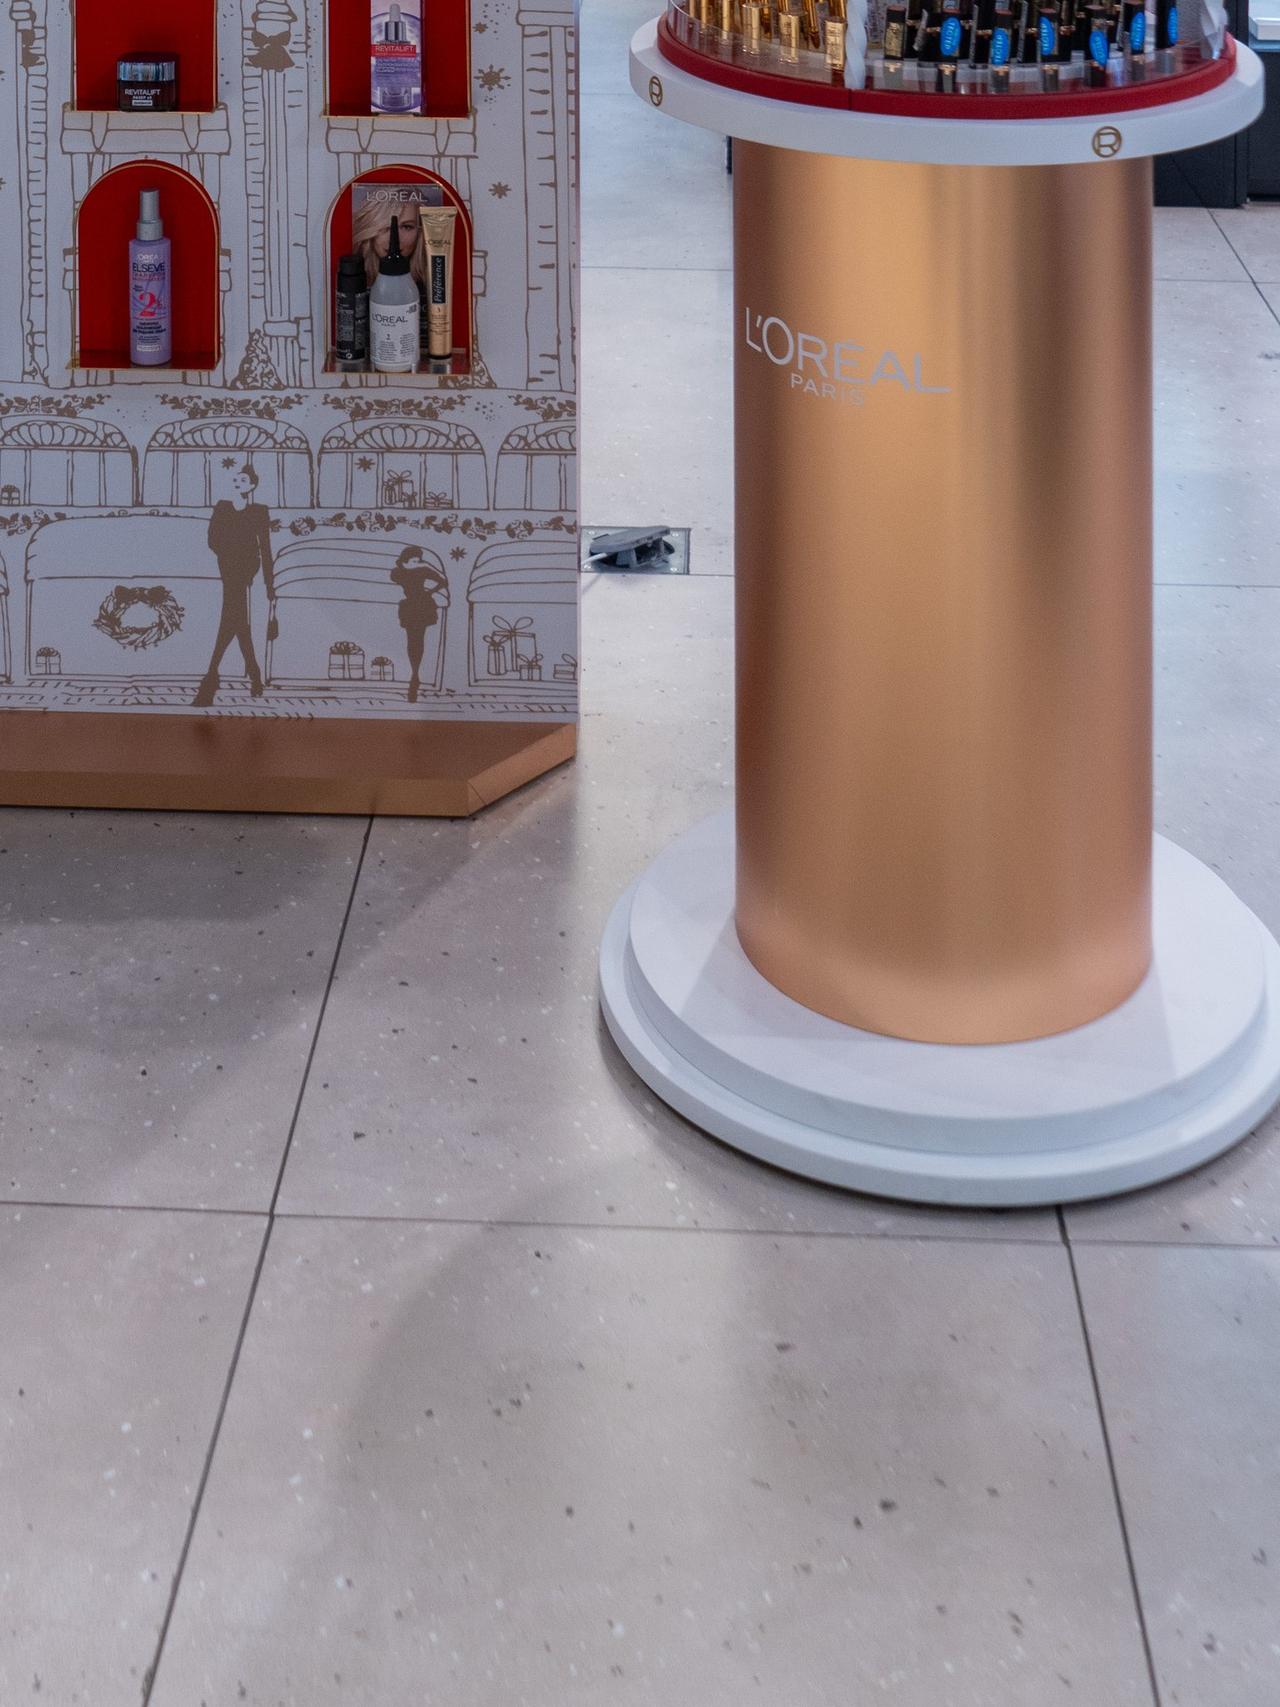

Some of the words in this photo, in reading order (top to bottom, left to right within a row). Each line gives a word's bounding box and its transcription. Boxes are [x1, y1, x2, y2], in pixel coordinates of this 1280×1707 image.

[132, 262, 166, 272] ELSEVE
[433, 257, 442, 303] Préférence
[745, 306, 950, 393] L'ORÉAL
